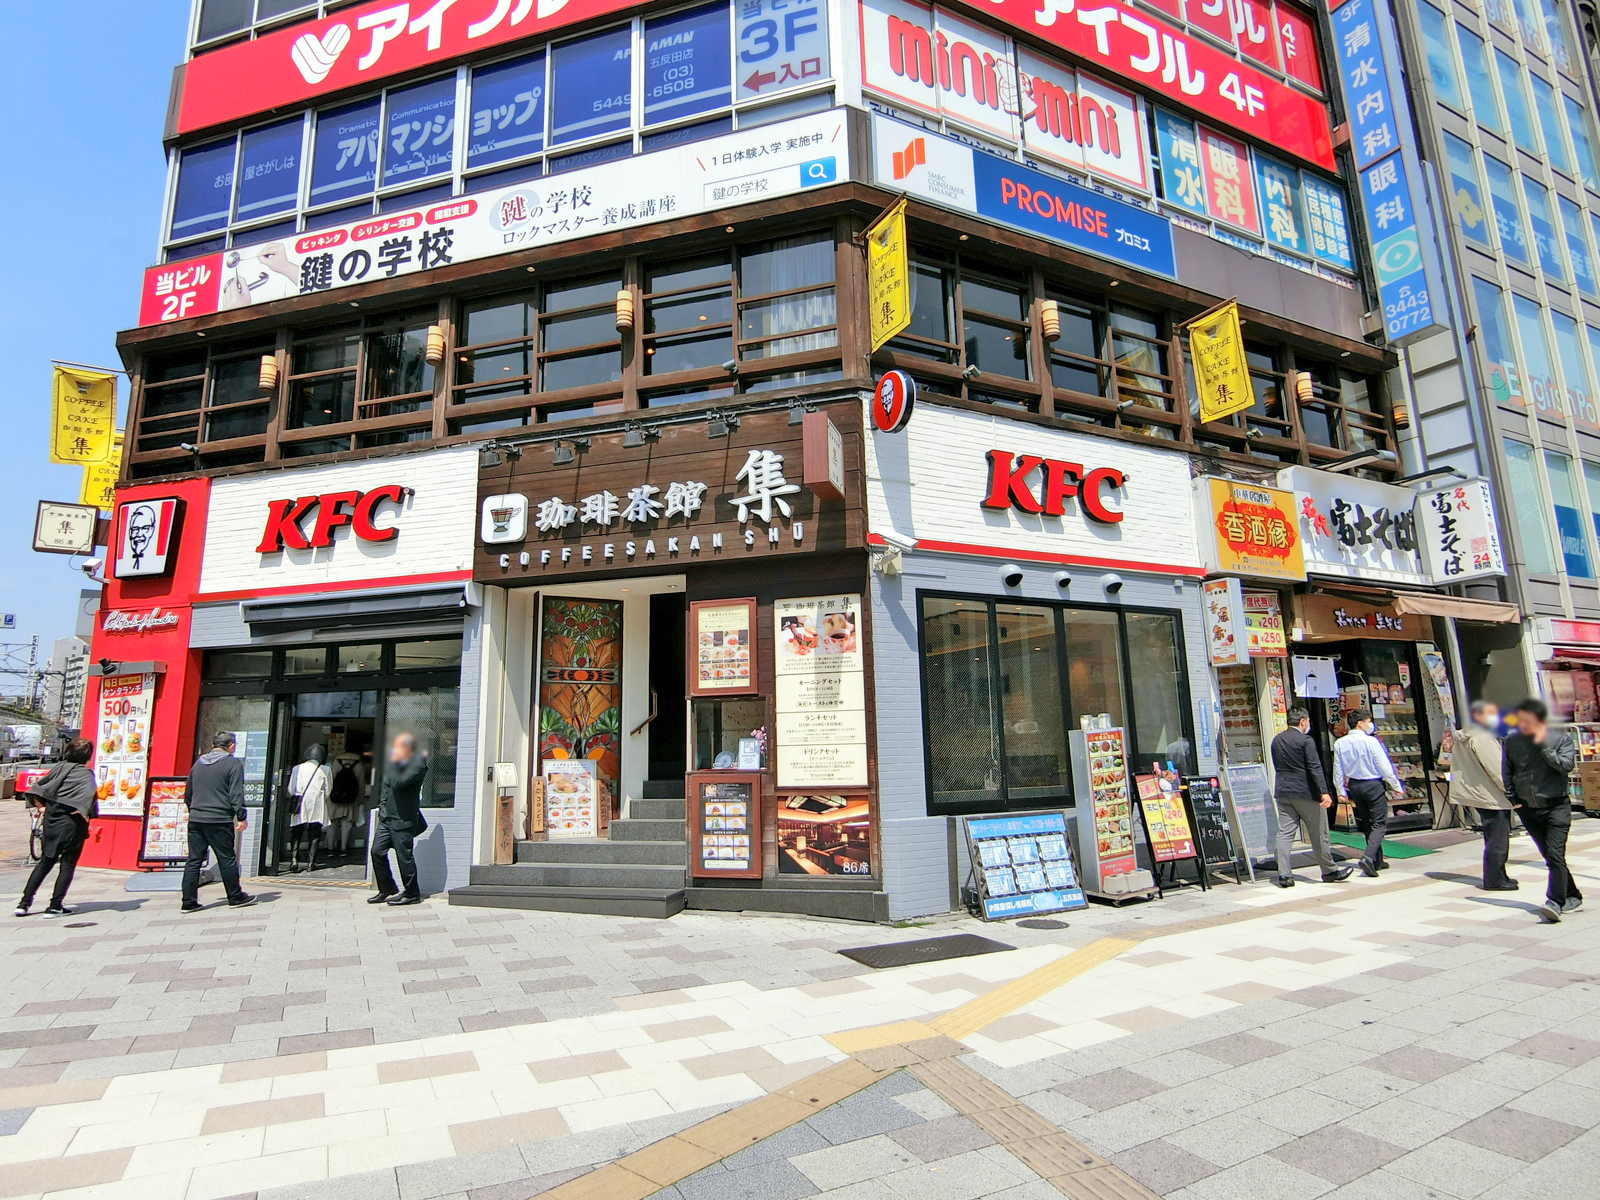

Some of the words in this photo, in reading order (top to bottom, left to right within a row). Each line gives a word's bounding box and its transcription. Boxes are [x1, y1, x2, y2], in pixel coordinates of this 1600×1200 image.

[741, 7, 818, 63] 3F
[649, 48, 694, 69] 五反田店
[778, 57, 821, 84] 入口
[663, 64, 694, 83] (03)
[1218, 72, 1265, 118] 4F
[1344, 22, 1392, 157] 清水内科
[338, 119, 379, 136] Dramatic
[786, 132, 823, 150] 実施中
[1167, 118, 1204, 207] 清水
[927, 171, 947, 182] SMBC
[927, 177, 966, 196] CONSUMER
[1207, 135, 1246, 226] 眼科
[712, 178, 769, 202] 鍵の学校
[928, 184, 959, 200] FINANCE
[1369, 160, 1405, 230] 眼科
[499, 185, 592, 227] 鍵の学校
[1001, 177, 1109, 238] PROMISE
[1263, 165, 1300, 249] 内科
[502, 195, 677, 246] ロックマスター養成講座
[1115, 228, 1152, 253] プロミス
[299, 226, 455, 294] 鍵の学校
[155, 264, 211, 297] 当ビル
[161, 293, 197, 322] 2F
[880, 301, 896, 329] 集
[1386, 290, 1429, 319] 3443
[1388, 307, 1431, 334] 0772
[1199, 336, 1231, 357] COFFEE
[1206, 357, 1230, 373] CAKE
[63, 396, 105, 408] COFFEE
[1215, 384, 1234, 405] 集
[67, 414, 99, 425] CAKE
[69, 436, 93, 456] 集
[535, 480, 708, 533] 珈琲茶館
[729, 449, 801, 524] 集
[980, 449, 1124, 524] KFC
[1453, 487, 1470, 512] 名代
[56, 520, 75, 535] 集
[256, 484, 404, 554] KFC
[1223, 511, 1290, 549] 香酒縁
[1301, 496, 1331, 538] 名代
[1330, 497, 1417, 552] 富士そば
[745, 522, 804, 546] SHU
[1431, 491, 1467, 576] 富士そば
[1473, 552, 1490, 564] 24
[1474, 561, 1492, 570] 時間
[840, 596, 853, 610] 集
[1258, 616, 1280, 628] ¥290
[1260, 631, 1282, 644] ¥250
[103, 685, 142, 697] ケンタランチ
[798, 678, 842, 686] モーニングセット
[804, 748, 840, 756] ドリンクセット
[1164, 809, 1184, 820] ¥290
[1168, 826, 1188, 837] ¥250
[842, 861, 869, 874] 86席
